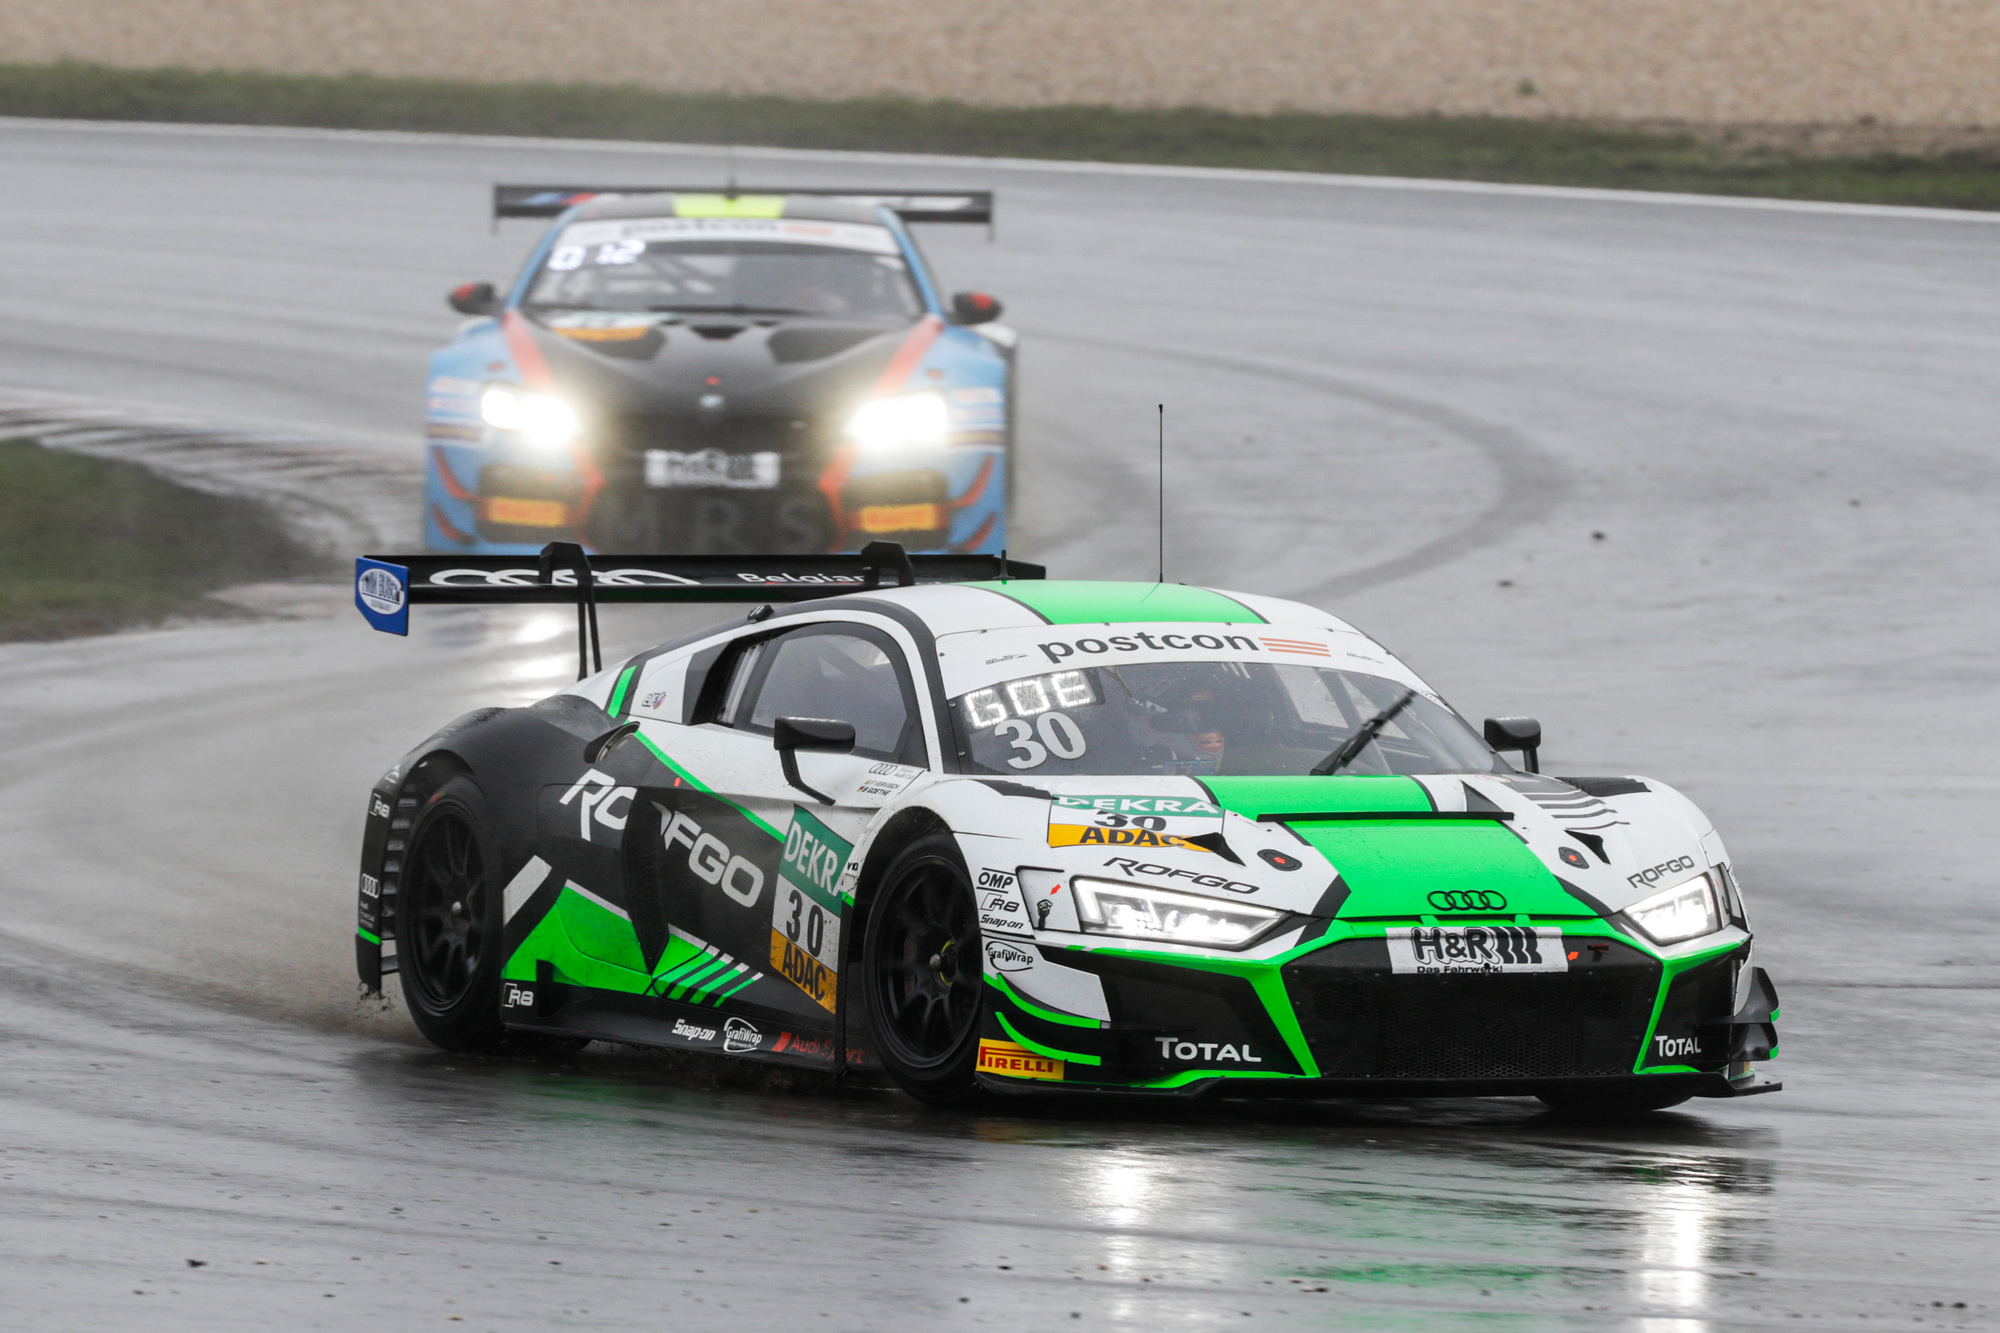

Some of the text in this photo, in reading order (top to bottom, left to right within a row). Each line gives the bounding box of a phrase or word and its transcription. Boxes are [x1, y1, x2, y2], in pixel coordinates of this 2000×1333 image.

[1038, 632, 1260, 664] postcon
[995, 711, 1087, 770] 30
[1056, 796, 1218, 813] DEKRA
[1094, 812, 1167, 831] 30
[1079, 826, 1187, 847] ADAC
[784, 821, 846, 897] DEKRA
[978, 871, 1013, 889] OMP
[1103, 857, 1259, 894] ROFGO
[1627, 855, 1695, 888] ROFGO
[786, 890, 824, 958] 30
[980, 914, 1024, 929] Snap-on
[987, 946, 1034, 965] GrafiWrap
[1411, 927, 1501, 965] H&R
[781, 949, 826, 1001] ADAC
[508, 984, 534, 1007] R8
[672, 1018, 716, 1041] Snap-on
[726, 1026, 762, 1046] GrafiWrap
[791, 1035, 821, 1054] Audi
[1155, 1036, 1262, 1062] TOTAL
[1655, 1035, 1702, 1057] TOTAL
[979, 1046, 1054, 1073] PIRELLI
